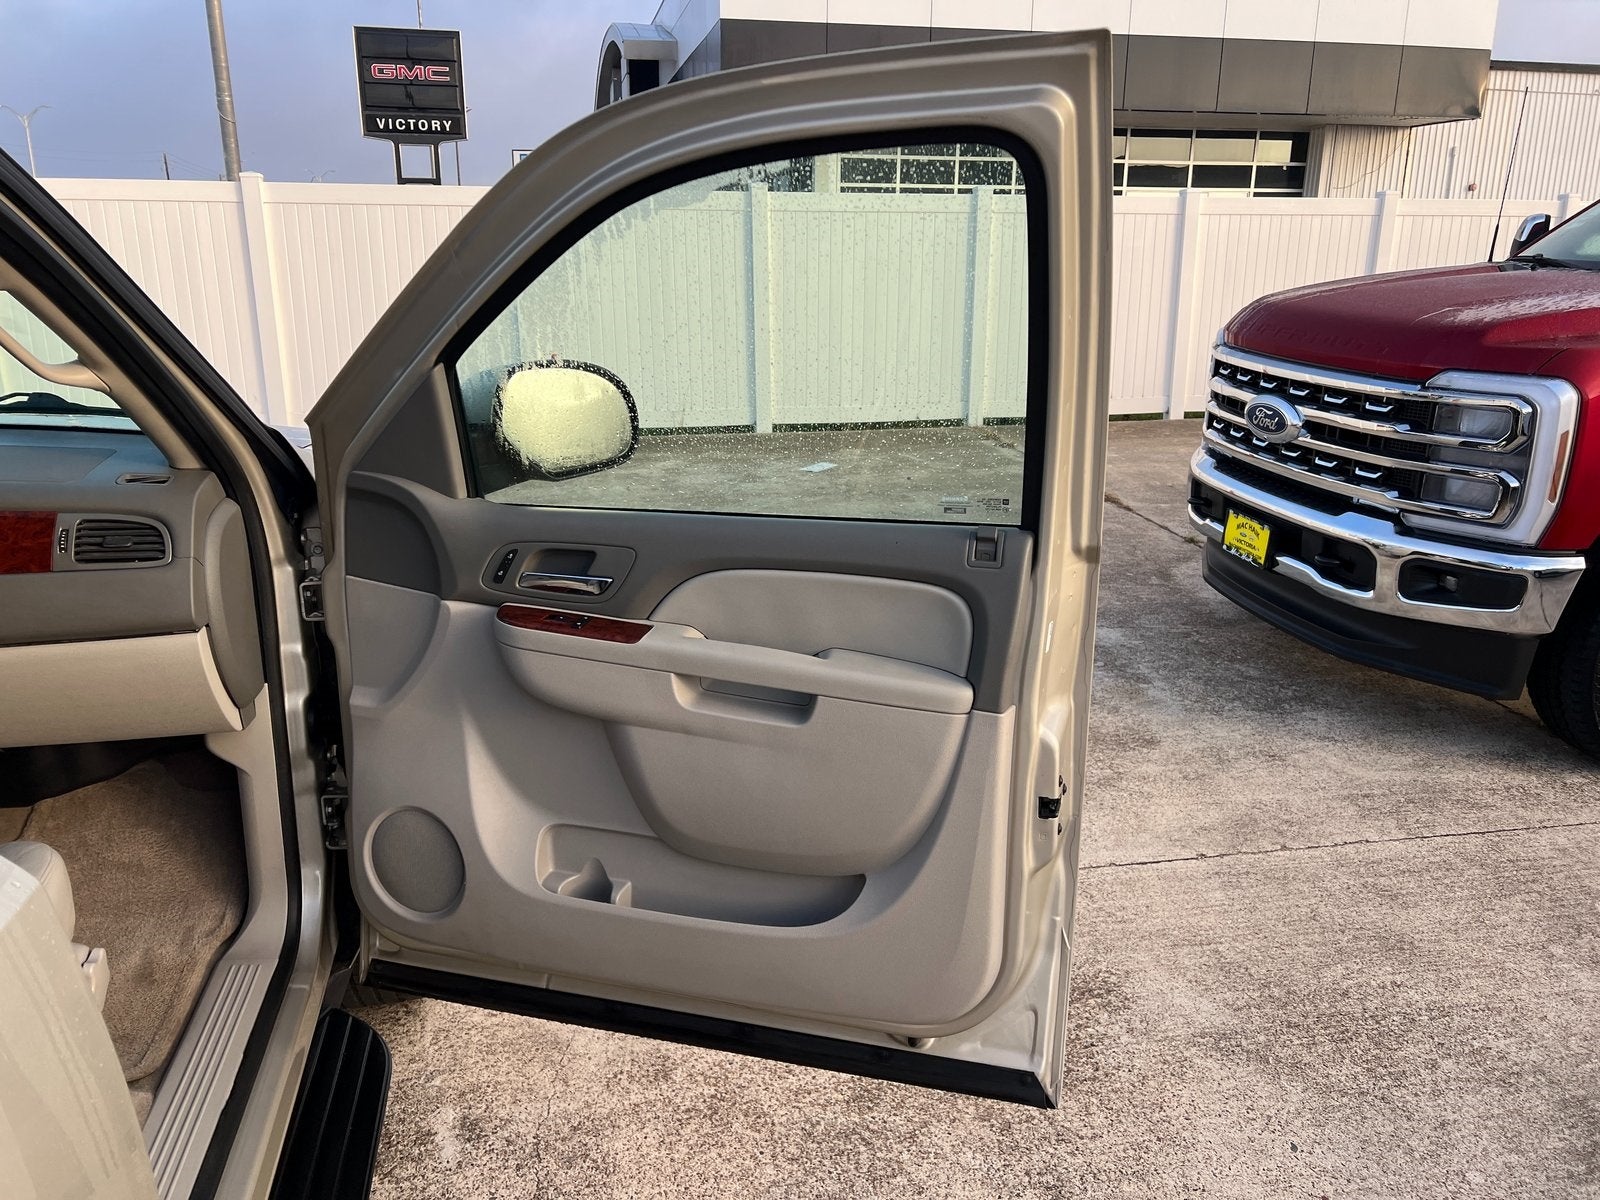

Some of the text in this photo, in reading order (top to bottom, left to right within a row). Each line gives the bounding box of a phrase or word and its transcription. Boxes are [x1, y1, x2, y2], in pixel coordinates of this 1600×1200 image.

[371, 63, 450, 81] GMC
[376, 118, 452, 131] VICTORY
[1253, 407, 1279, 430] Ford
